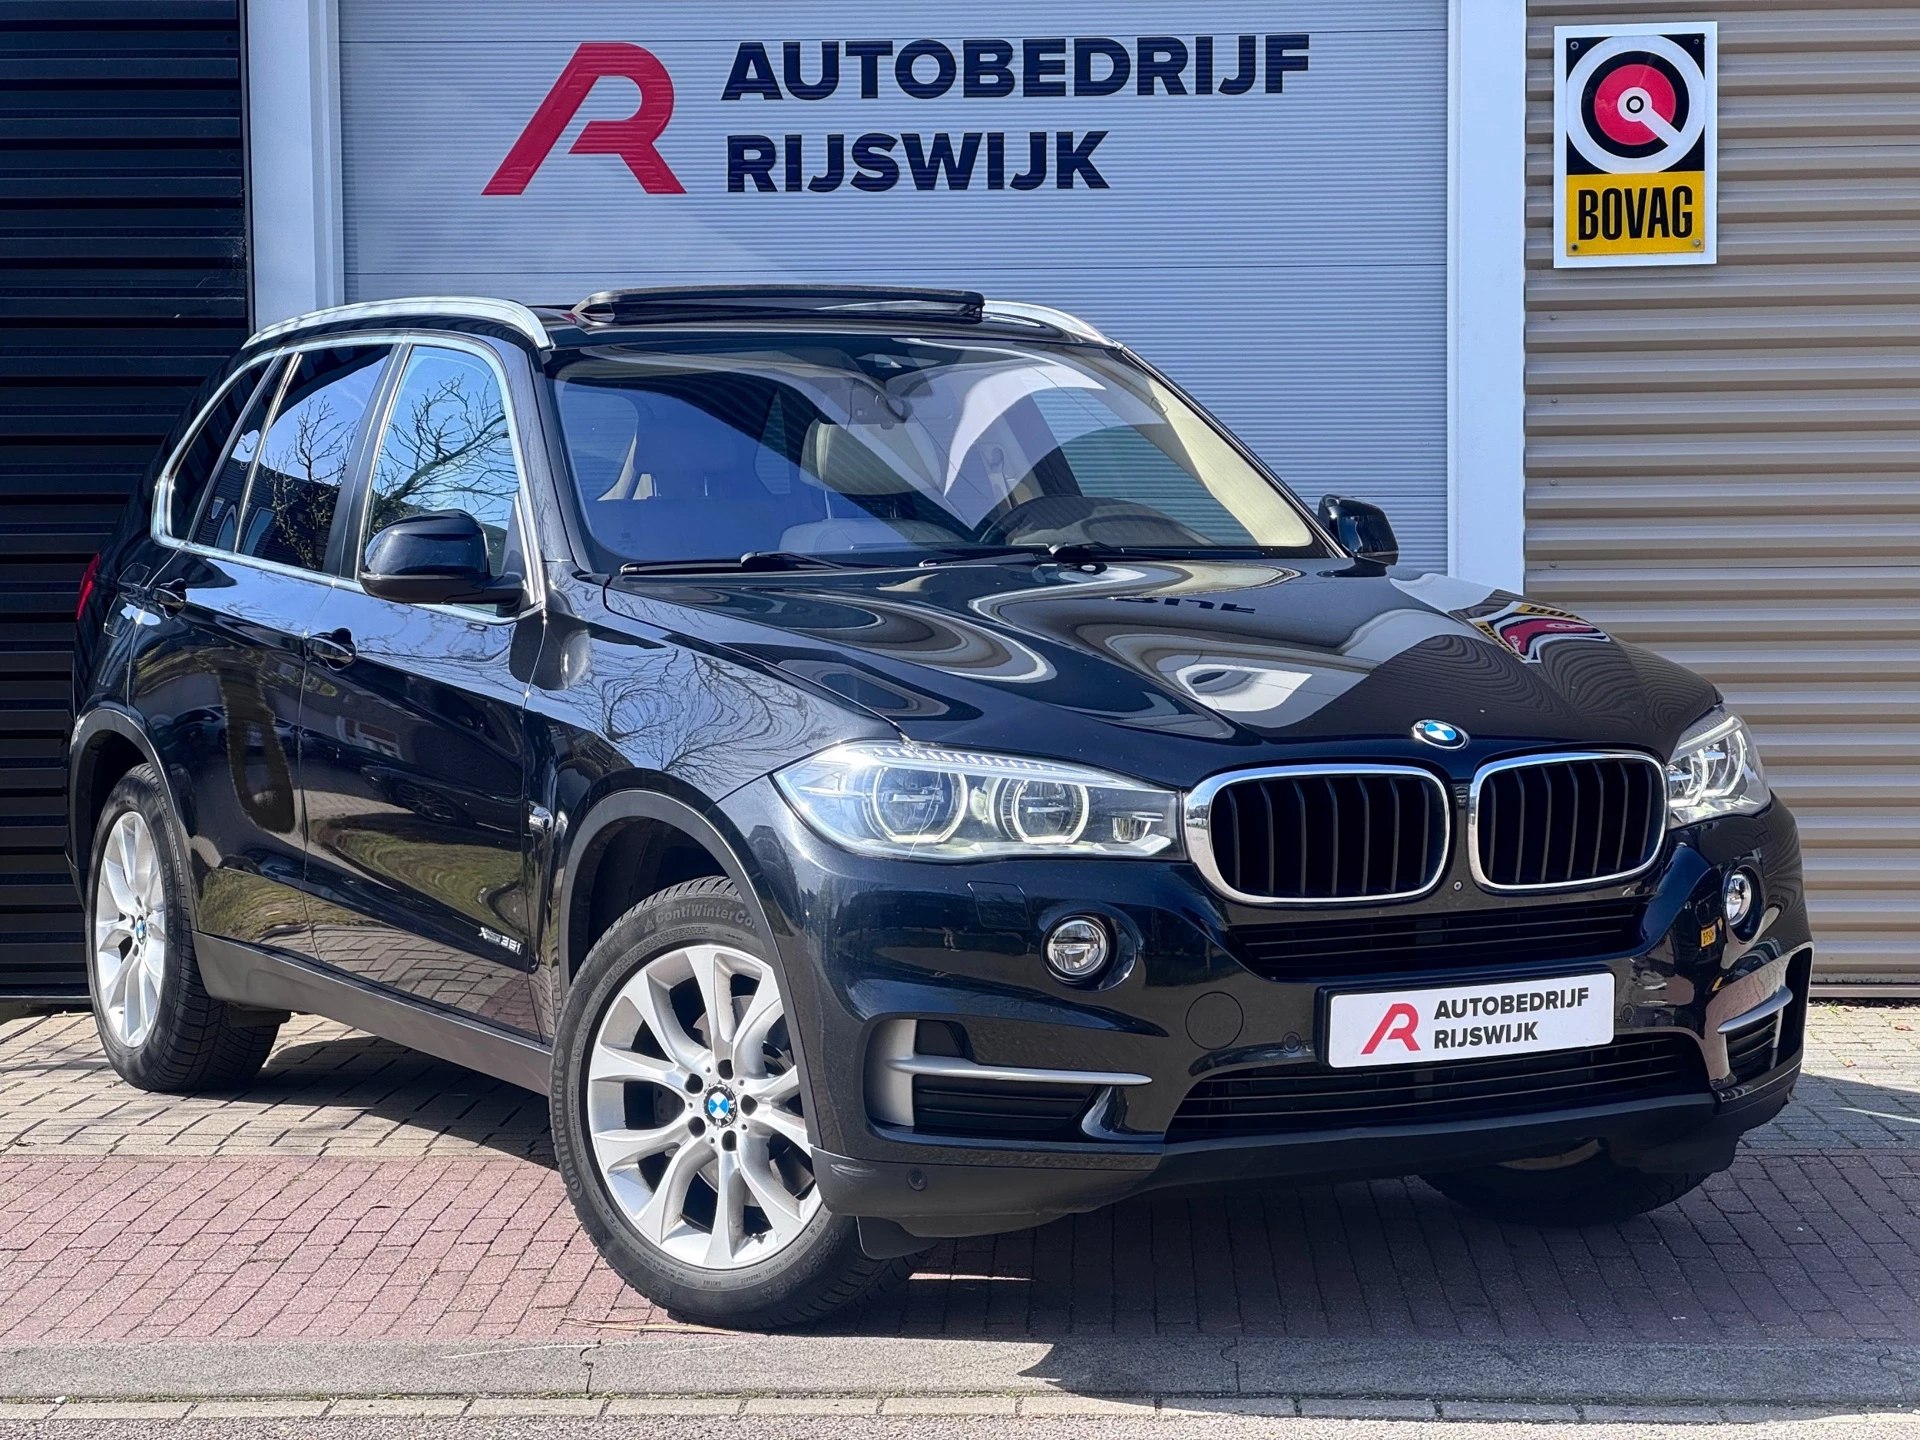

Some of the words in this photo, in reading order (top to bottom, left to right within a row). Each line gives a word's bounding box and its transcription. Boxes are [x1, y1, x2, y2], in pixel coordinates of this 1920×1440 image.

[721, 35, 1310, 100] AUTOBEDRIJF
[727, 131, 1110, 192] RIJSWIJK
[1578, 186, 1693, 240] BOVAG
[655, 904, 757, 930] ContiWinterCo
[1433, 987, 1590, 1020] AUTOBEDRIJF
[1434, 1021, 1539, 1050] RIJSWIJK
